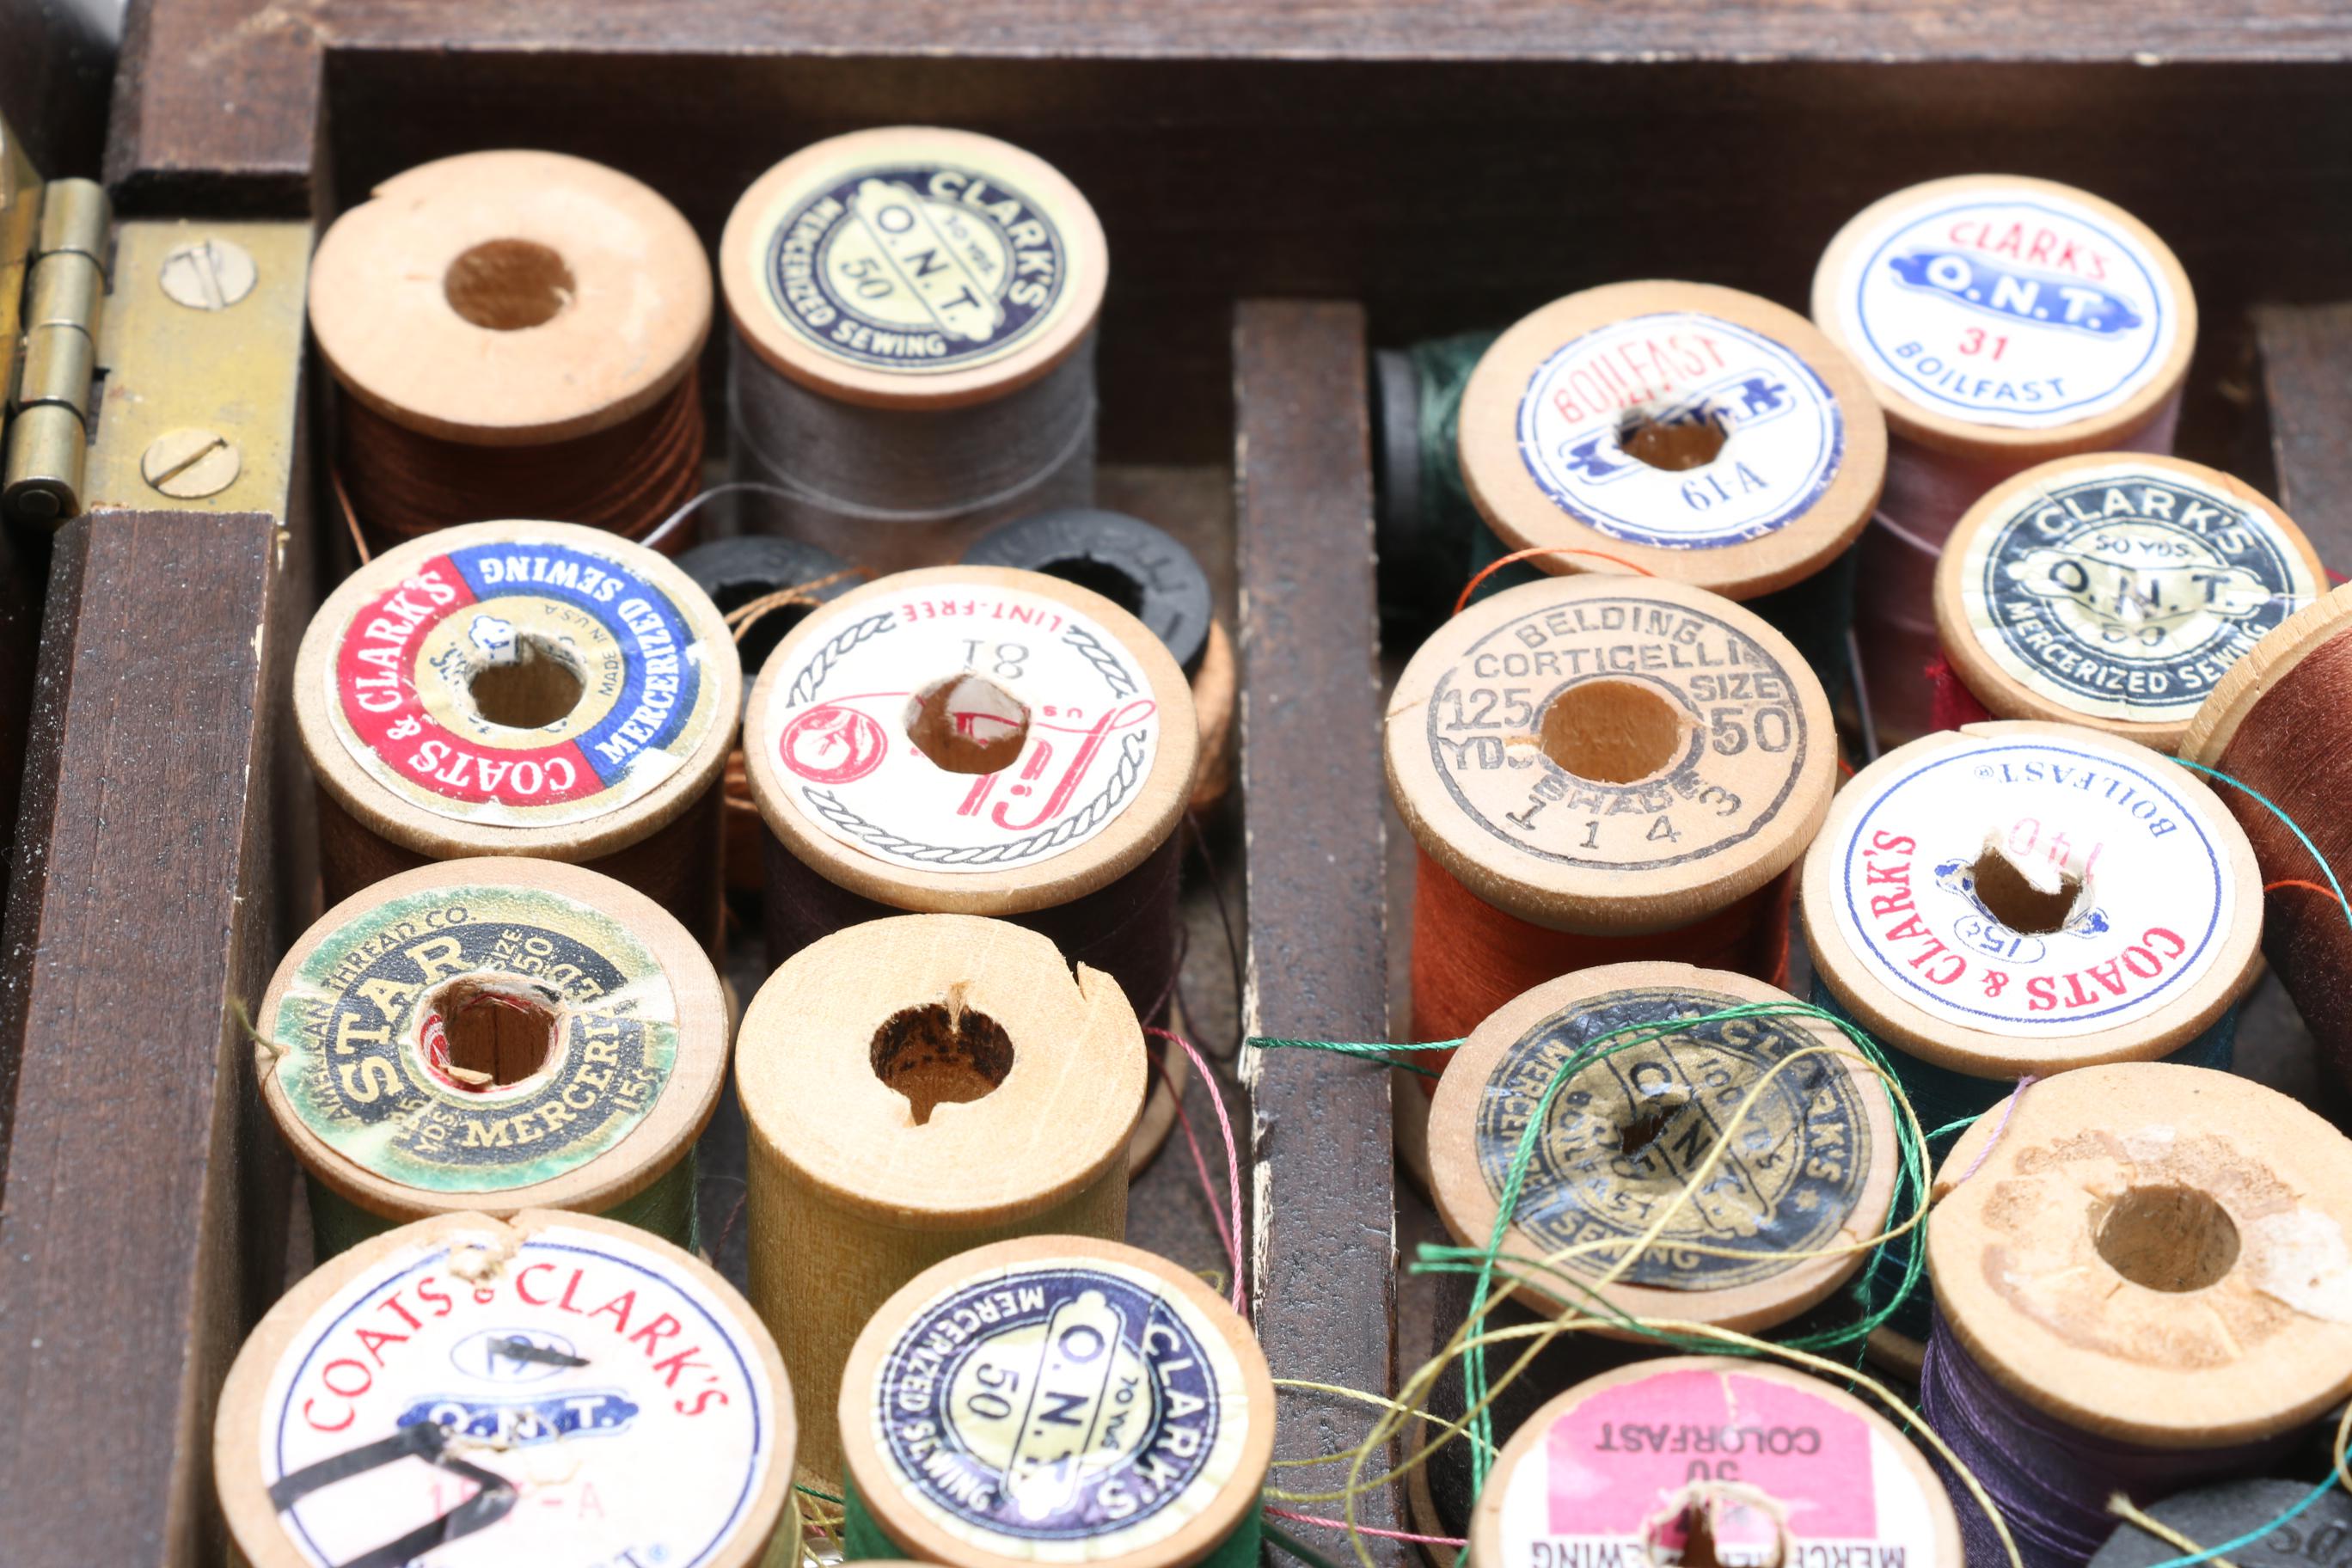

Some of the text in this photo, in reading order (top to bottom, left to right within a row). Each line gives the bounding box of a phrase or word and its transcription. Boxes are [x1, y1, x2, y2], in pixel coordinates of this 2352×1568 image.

[878, 205, 980, 322] O.N.T.
[928, 171, 1056, 308] CLARK'S
[841, 255, 894, 300] 50
[1926, 254, 2104, 330] O.N.T.
[830, 320, 946, 358] SEWING
[1958, 327, 2009, 362] 31
[1895, 340, 2067, 402] BOILFAST
[2036, 487, 2257, 555] CLARK'S
[355, 570, 457, 713] CLARK'S
[903, 600, 1064, 634] LINT-FREE
[1515, 606, 1705, 649] BELDING
[478, 555, 680, 766] MERCERIZED SEWING
[1473, 640, 1742, 678] CORTICELLI
[2005, 600, 2168, 694] MERCERIZED
[1441, 688, 1534, 732] 125
[1689, 671, 1783, 702] SIZE
[386, 714, 422, 741] &
[1712, 707, 1792, 756] 50
[407, 739, 578, 794] COATS
[425, 905, 477, 929] CO.
[1861, 830, 2187, 1012] COATS & CLARK'S
[511, 936, 554, 975] 50
[334, 934, 478, 1106] STAR
[1551, 1210, 1704, 1271] SEWNG
[303, 1276, 454, 1434] COATS
[515, 1263, 730, 1418] CLARK'S
[899, 1284, 1046, 1513] MERCERIZED SEWING
[967, 1363, 1020, 1422] 50
[1097, 1323, 1205, 1520] CLARK'S
[1594, 1420, 1822, 1456] COLORFAST
